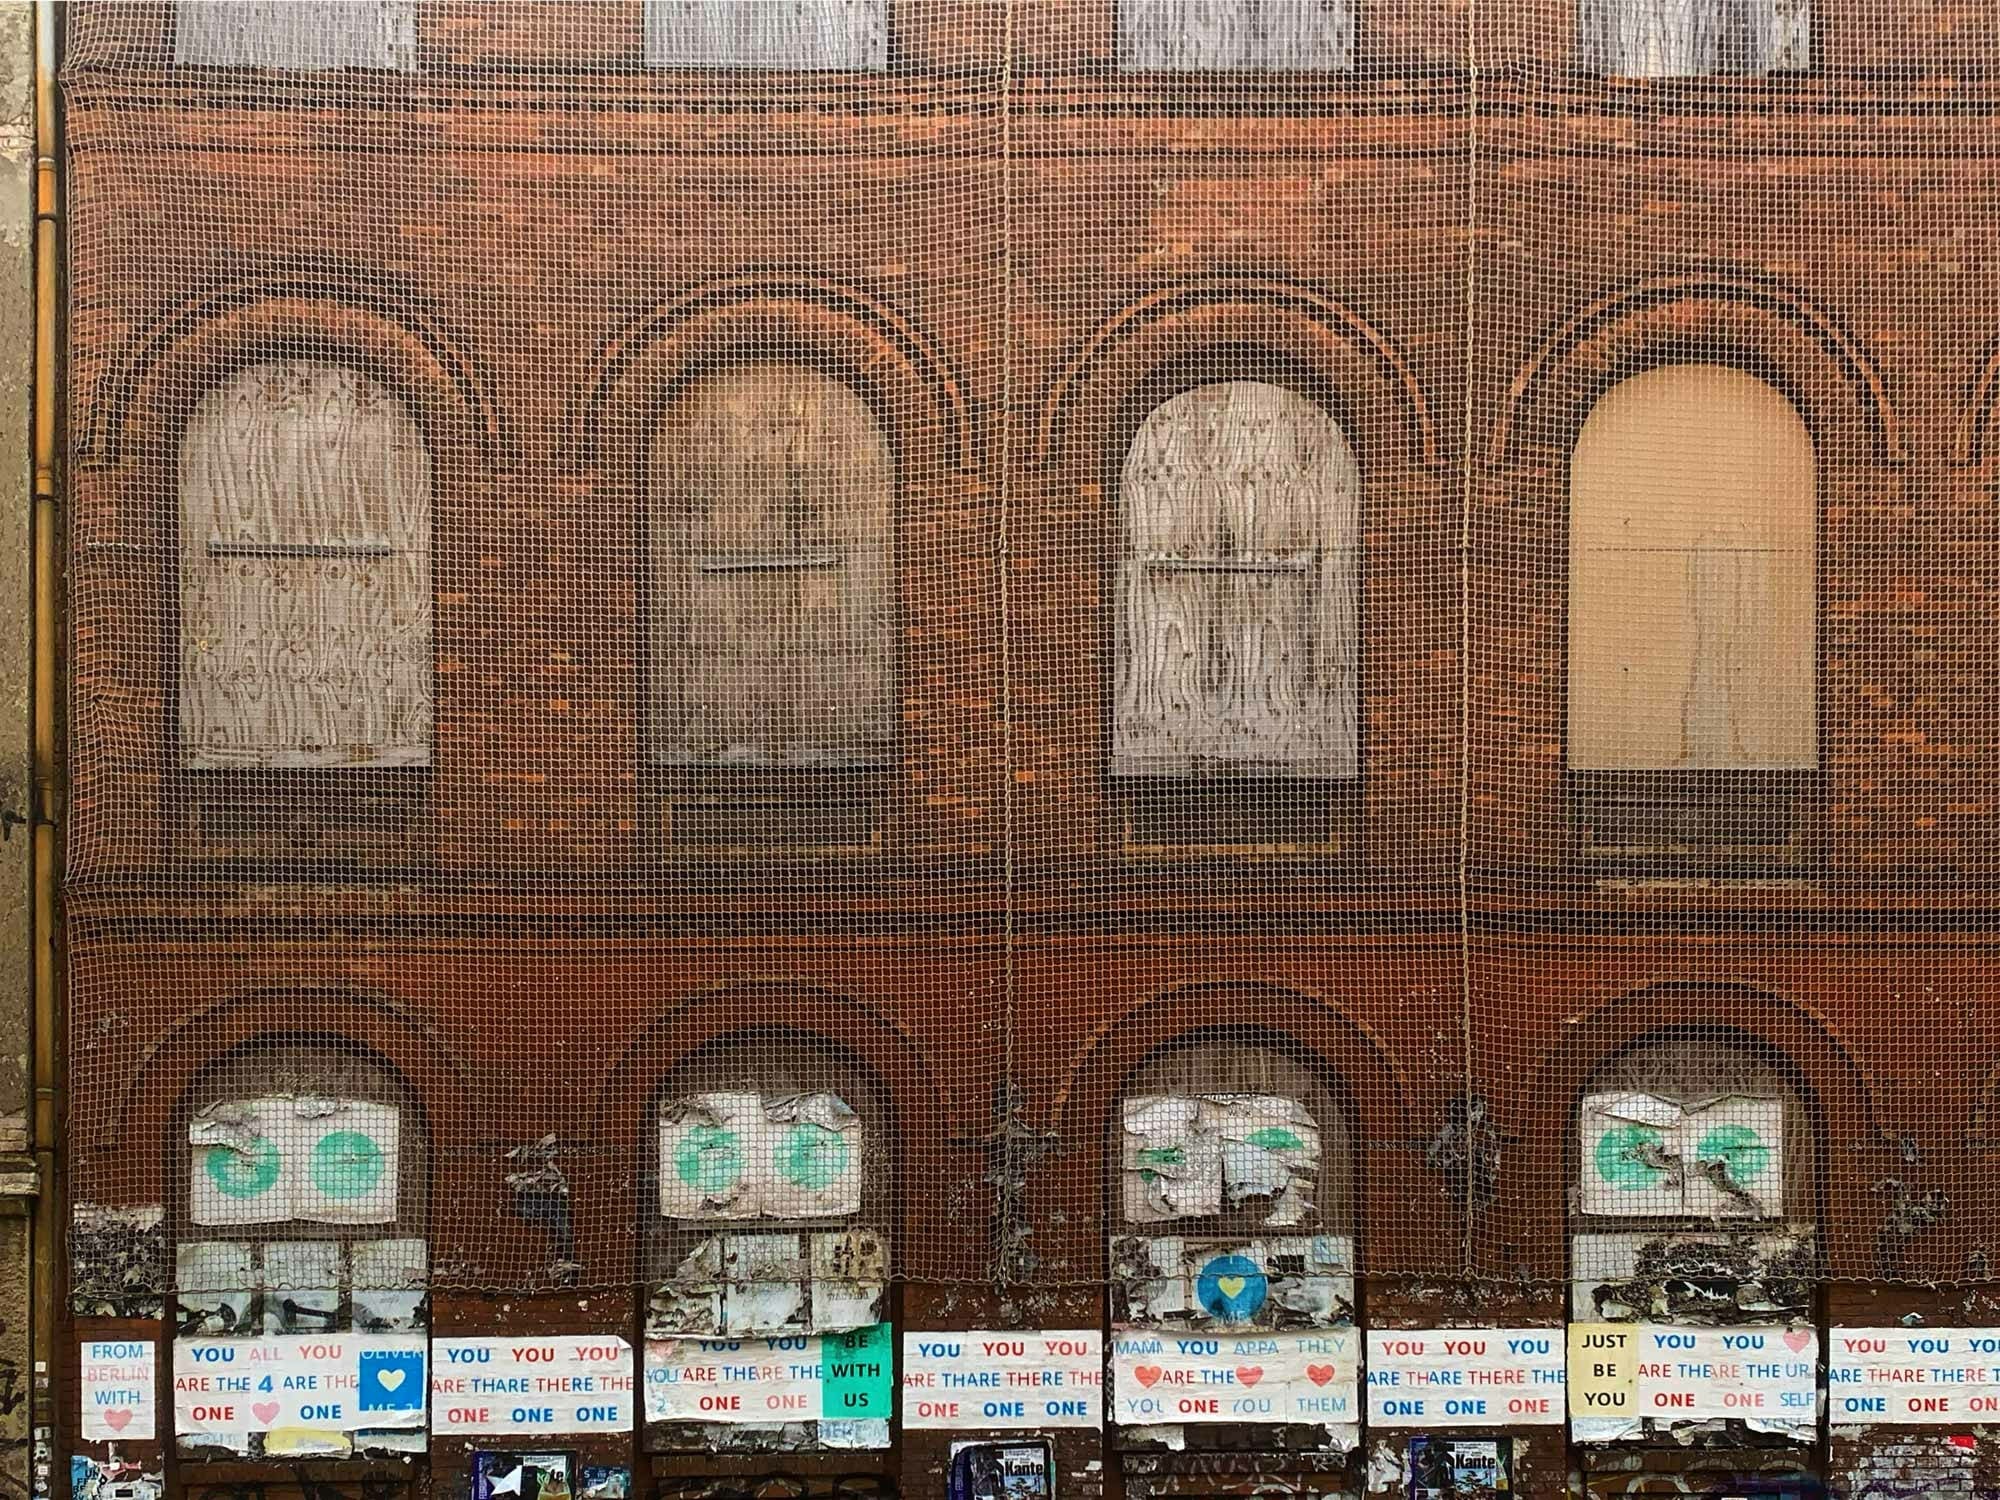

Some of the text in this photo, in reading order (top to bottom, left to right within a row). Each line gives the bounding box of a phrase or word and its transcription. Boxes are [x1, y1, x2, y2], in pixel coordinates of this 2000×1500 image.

[766, 1335, 808, 1350] YOU
[845, 1334, 869, 1348] BE
[1177, 1340, 1218, 1355] YOU
[1296, 1339, 1345, 1353] THEY
[1382, 1340, 1549, 1356] YOU YOU YOU
[1582, 1334, 1627, 1348] JUST
[1654, 1334, 1764, 1350] YOU YOU
[1844, 1339, 2000, 1354] YOU YOU YO
[92, 1344, 143, 1359] FROM
[192, 1345, 341, 1362] YOU ALL YOU
[447, 1346, 619, 1363] YOU YOU YOU
[919, 1341, 1087, 1358] YOU YOU YOU
[87, 1366, 149, 1382] BERLIN
[646, 1367, 679, 1383] YOU
[684, 1367, 716, 1382] ARE
[789, 1365, 823, 1379] THE
[831, 1363, 880, 1378] WITH
[1163, 1369, 1234, 1384] ARE THE
[1368, 1371, 1400, 1386] ARE
[1532, 1369, 1565, 1384] THE
[1593, 1364, 1616, 1377] BE
[1639, 1364, 1671, 1378] ARE
[1746, 1363, 1780, 1378] THE
[1829, 1368, 1862, 1383] ARE
[176, 1374, 358, 1392] ARE THE 4 ARE THE
[433, 1378, 465, 1393] ARE
[600, 1376, 633, 1391] THE
[903, 1373, 936, 1387] ARE
[1069, 1371, 1102, 1385] THE
[95, 1390, 141, 1405] WITH
[699, 1396, 741, 1411] ONE
[766, 1394, 807, 1409] ONE
[844, 1393, 869, 1407] US
[1178, 1399, 1219, 1413] ONE
[1296, 1397, 1346, 1412] THEM
[1584, 1392, 1625, 1406] YOU
[1654, 1392, 1814, 1407] ONE ONE SELF
[1845, 1397, 1998, 1412] ONE ONE ON
[192, 1404, 341, 1420] ONE ONE
[448, 1406, 617, 1423] ONE ONE ONE
[918, 1401, 1087, 1417] ONE ONE ONE
[1383, 1399, 1549, 1415] ONE ONE ONE
[1005, 1461, 1043, 1476] Kante
[1456, 1454, 1495, 1469] Kante
